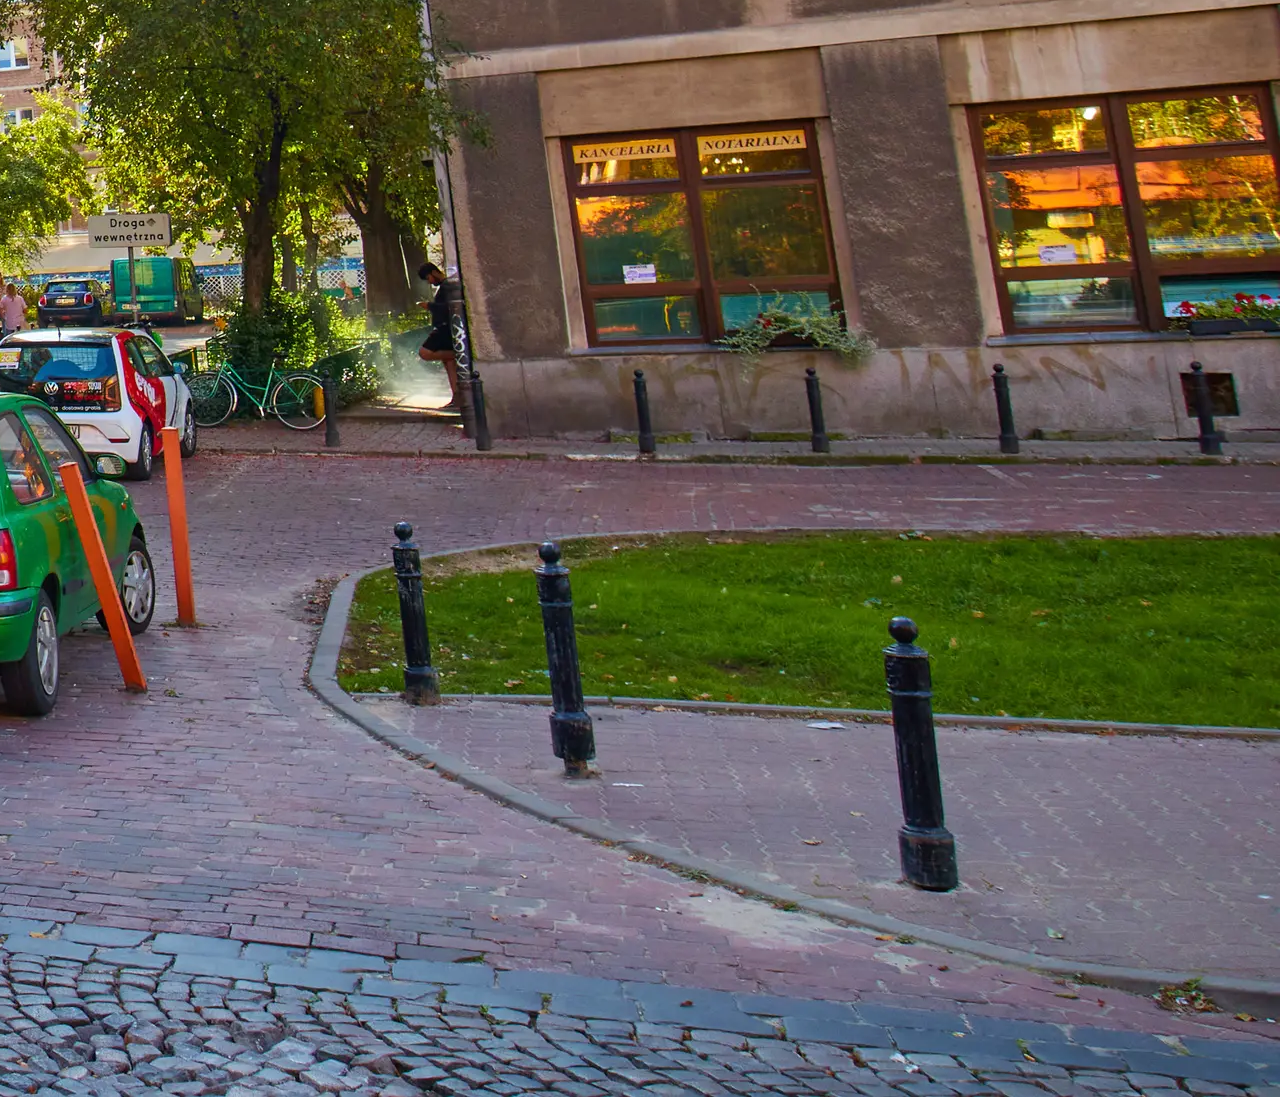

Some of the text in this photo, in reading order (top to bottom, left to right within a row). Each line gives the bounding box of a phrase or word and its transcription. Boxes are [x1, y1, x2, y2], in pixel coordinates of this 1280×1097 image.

[579, 135, 802, 159] KANCELARIA NOTARIALNA
[110, 218, 146, 230] Droga
[94, 232, 164, 244] wewnętrzna
[61, 404, 84, 412] dostawa
[84, 404, 102, 413] gratis
